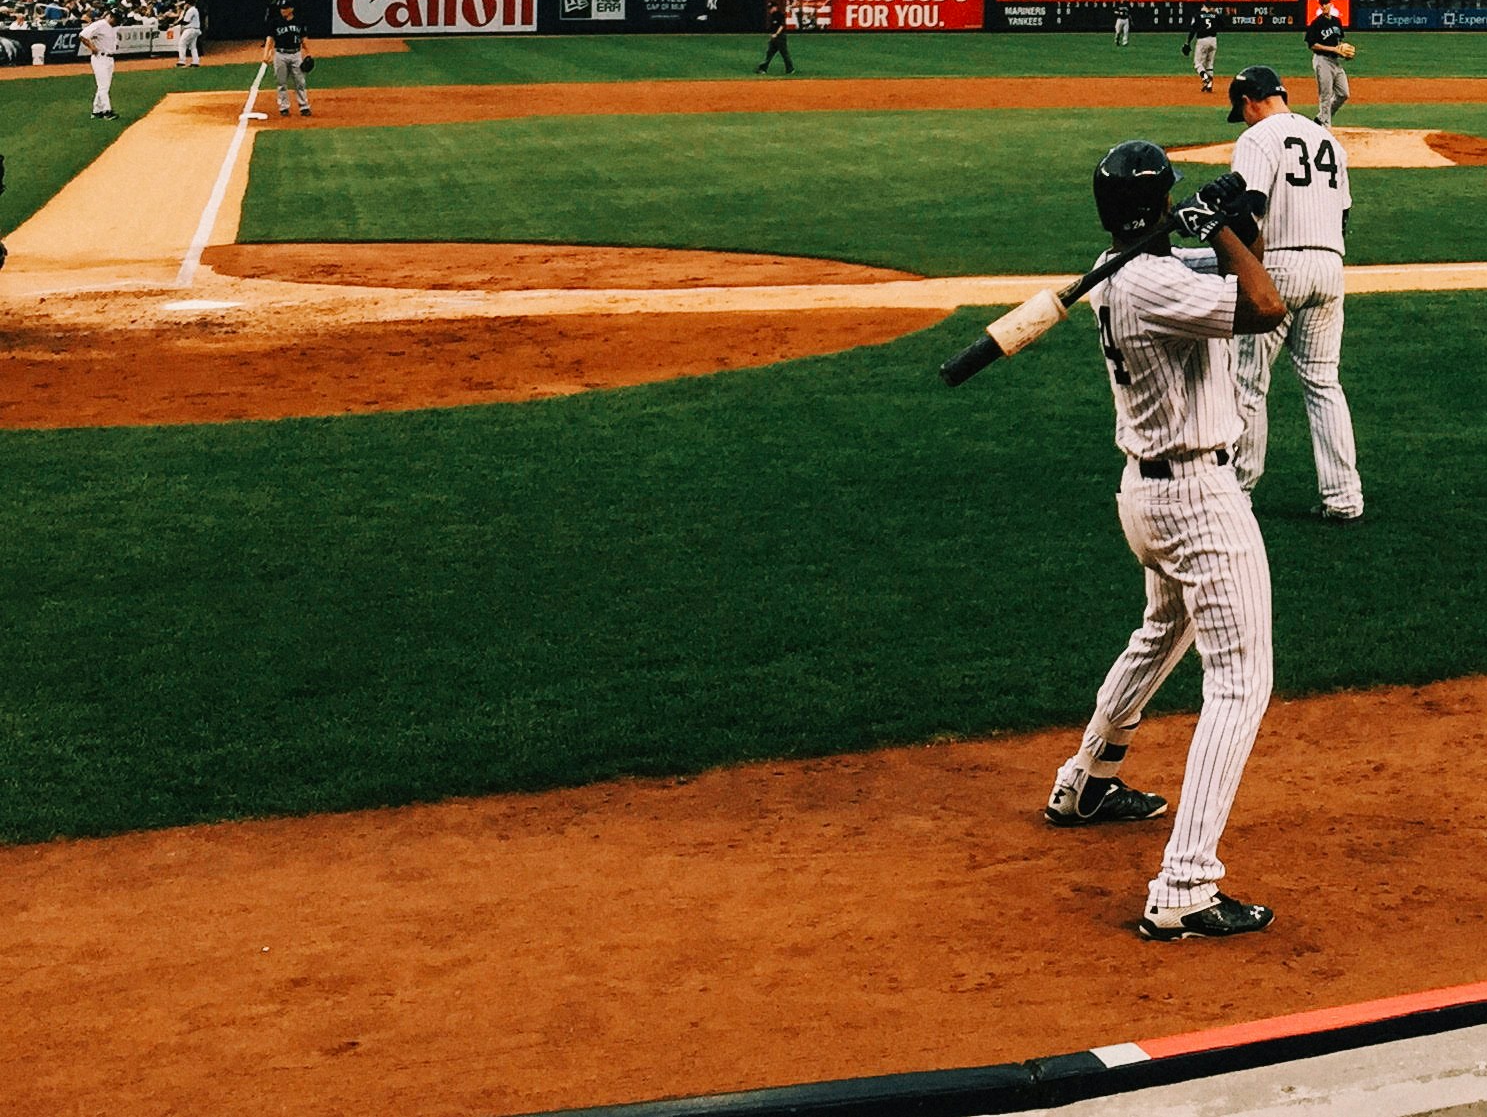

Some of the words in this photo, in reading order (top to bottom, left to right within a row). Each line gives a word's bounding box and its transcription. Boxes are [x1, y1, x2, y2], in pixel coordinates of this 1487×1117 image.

[597, 3, 621, 12] ERA
[845, 5, 889, 27] FOR
[894, 5, 944, 27] YOU.
[1387, 15, 1427, 26] Experian
[1205, 19, 1211, 29] 5
[53, 34, 77, 49] ACC
[1284, 137, 1338, 189] 34
[1132, 219, 1146, 229] 24
